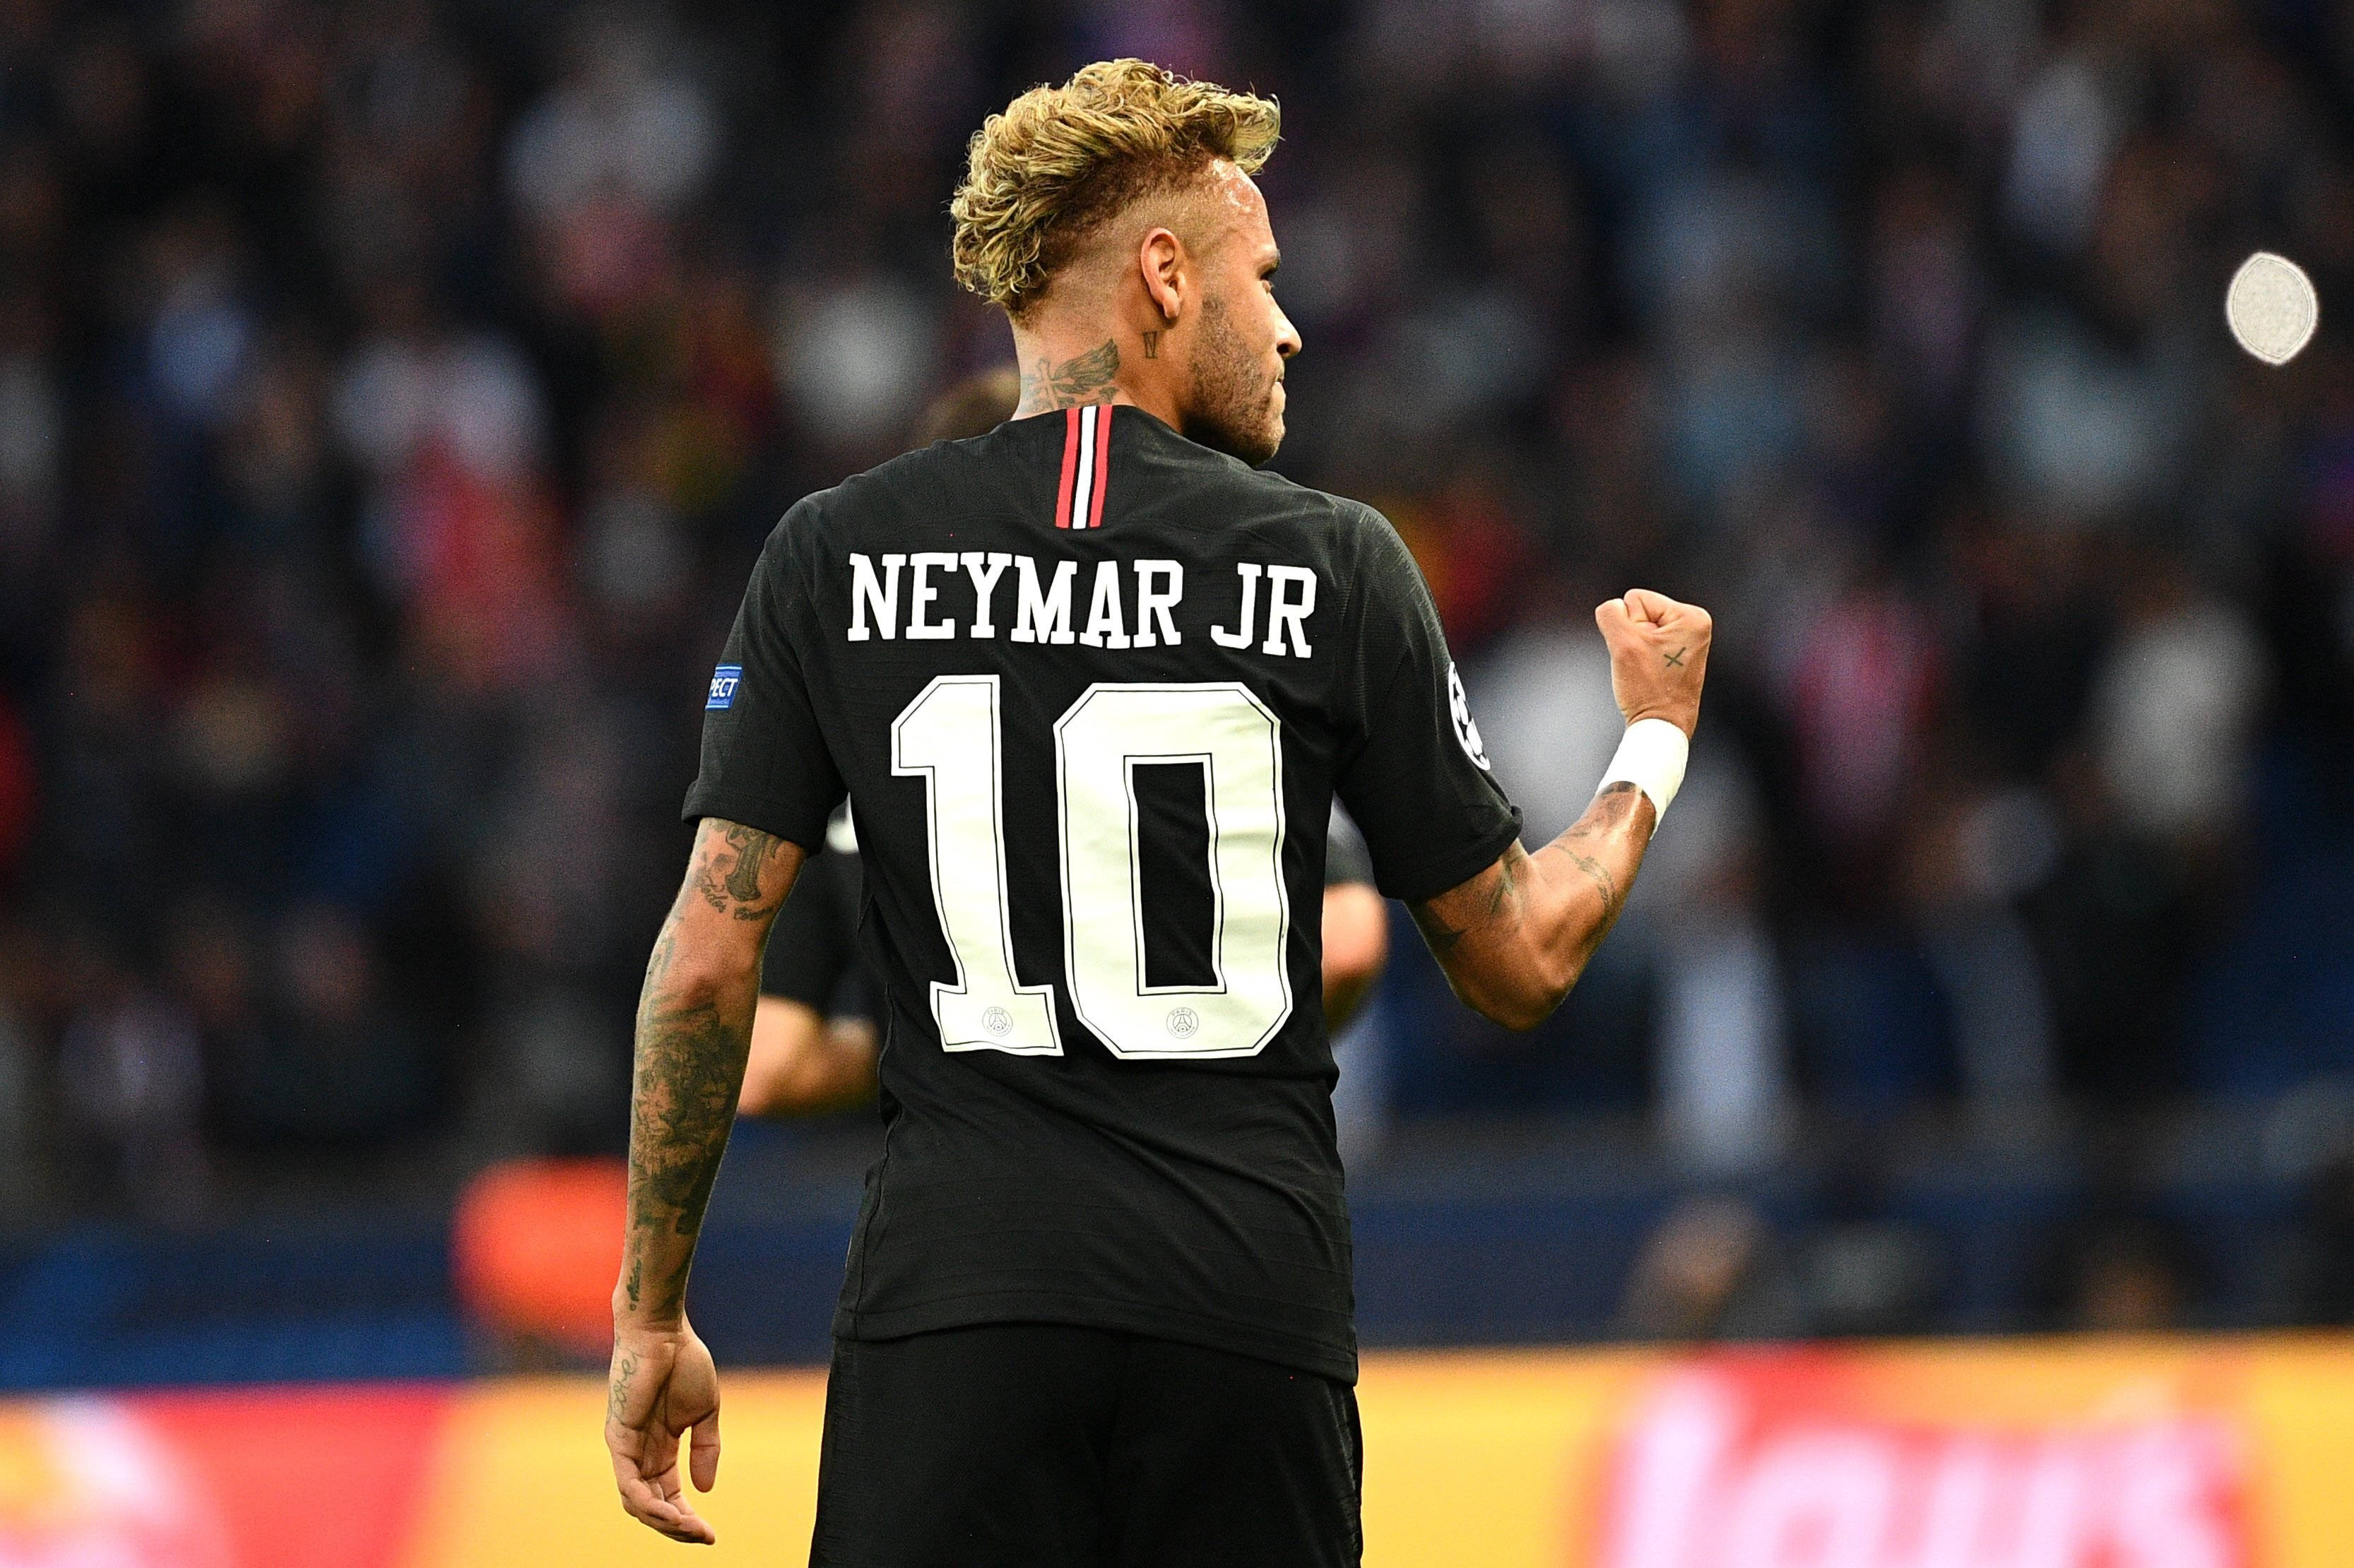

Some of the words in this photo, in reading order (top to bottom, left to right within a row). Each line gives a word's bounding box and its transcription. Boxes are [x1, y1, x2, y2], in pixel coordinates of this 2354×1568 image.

[848, 552, 1183, 648] NEYMAR
[1211, 563, 1317, 658] JR
[891, 675, 1293, 1059] 10
